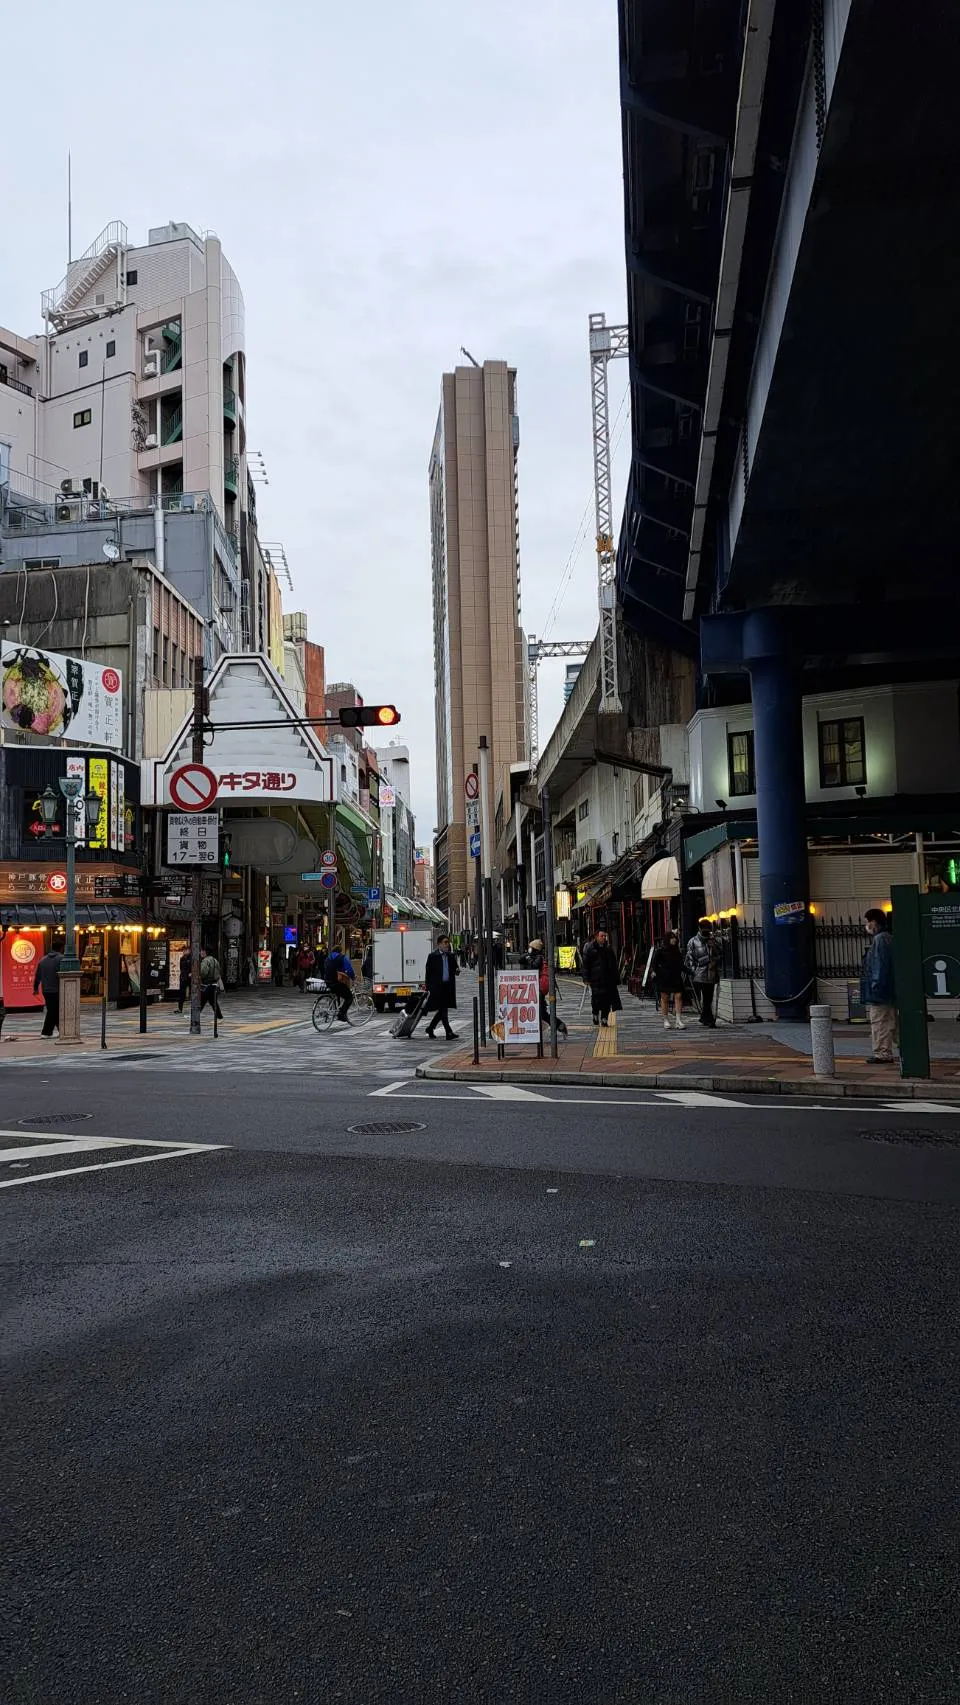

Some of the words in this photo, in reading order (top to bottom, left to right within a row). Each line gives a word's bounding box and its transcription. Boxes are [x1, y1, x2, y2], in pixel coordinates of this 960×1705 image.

[104, 695, 113, 743] 賀正軒
[8, 873, 47, 882] 神戸豚骨
[8, 883, 47, 891] らーめん
[499, 984, 538, 1004] PIZZA
